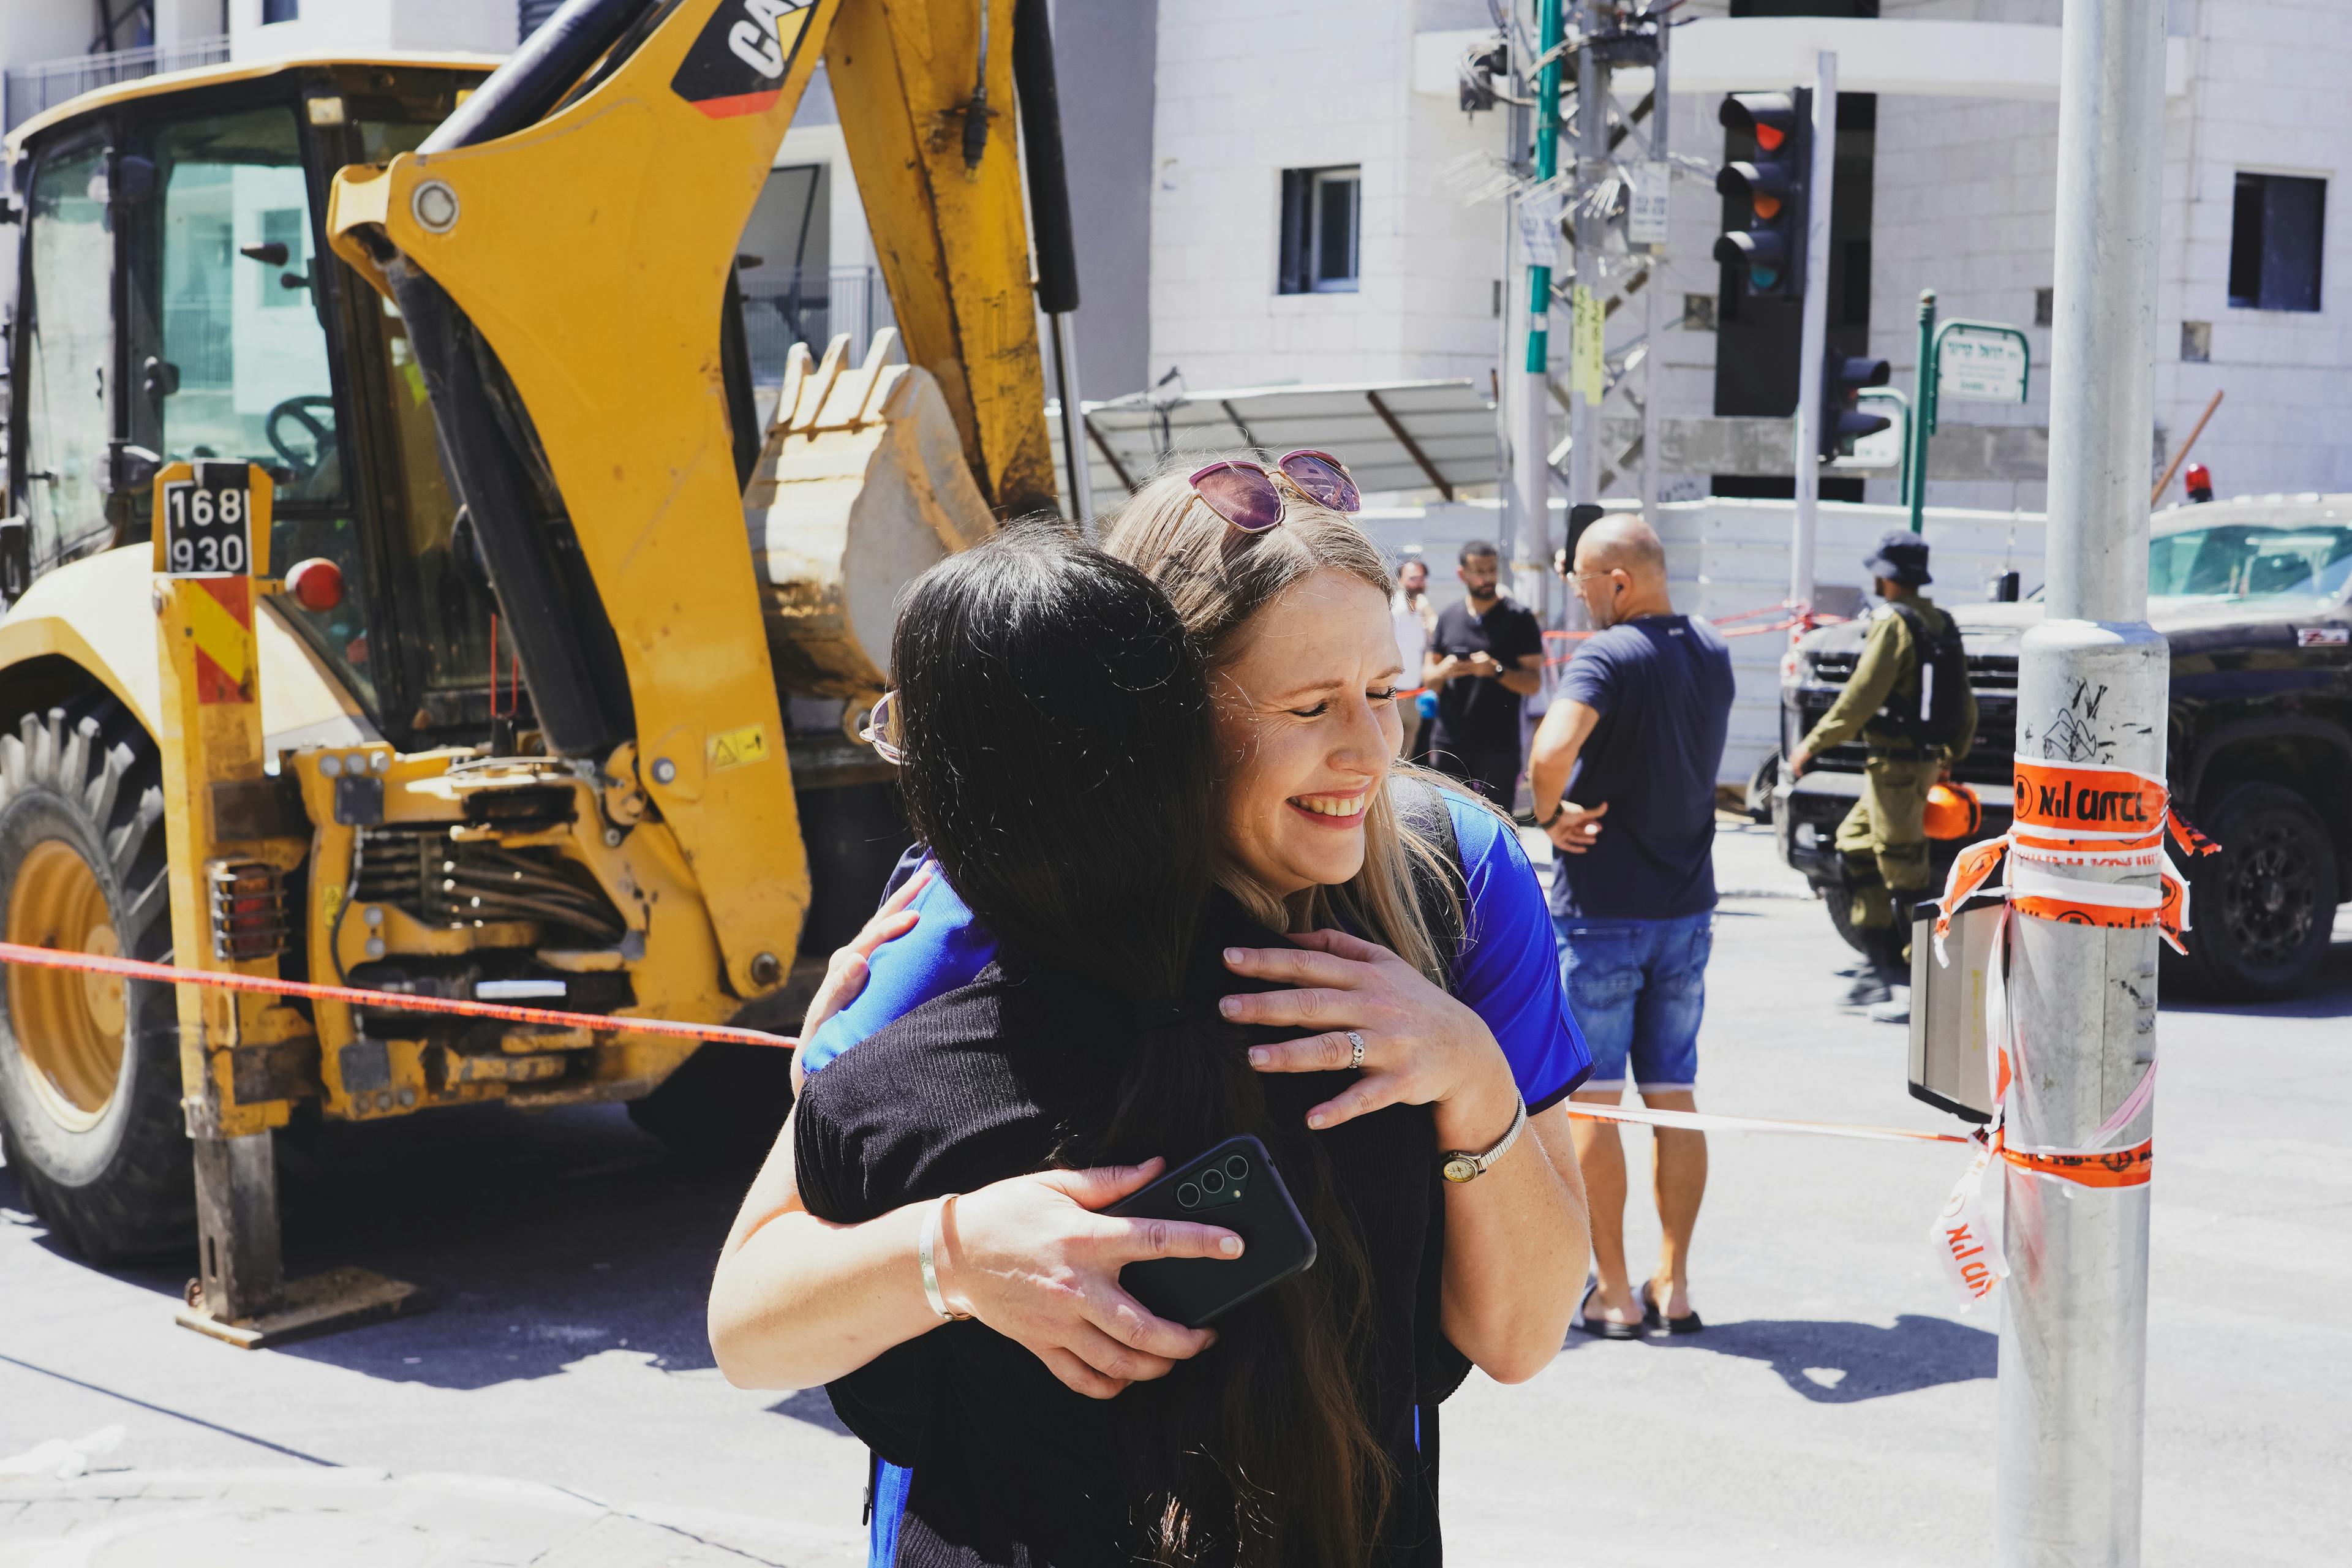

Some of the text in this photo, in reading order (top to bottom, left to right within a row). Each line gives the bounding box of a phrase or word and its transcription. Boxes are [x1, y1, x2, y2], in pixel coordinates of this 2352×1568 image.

[728, 0, 814, 79] CA
[171, 489, 241, 529] 168
[173, 534, 244, 572] 930
[2038, 781, 2149, 822] אין מעבר
[1946, 1223, 1985, 1261] אין
